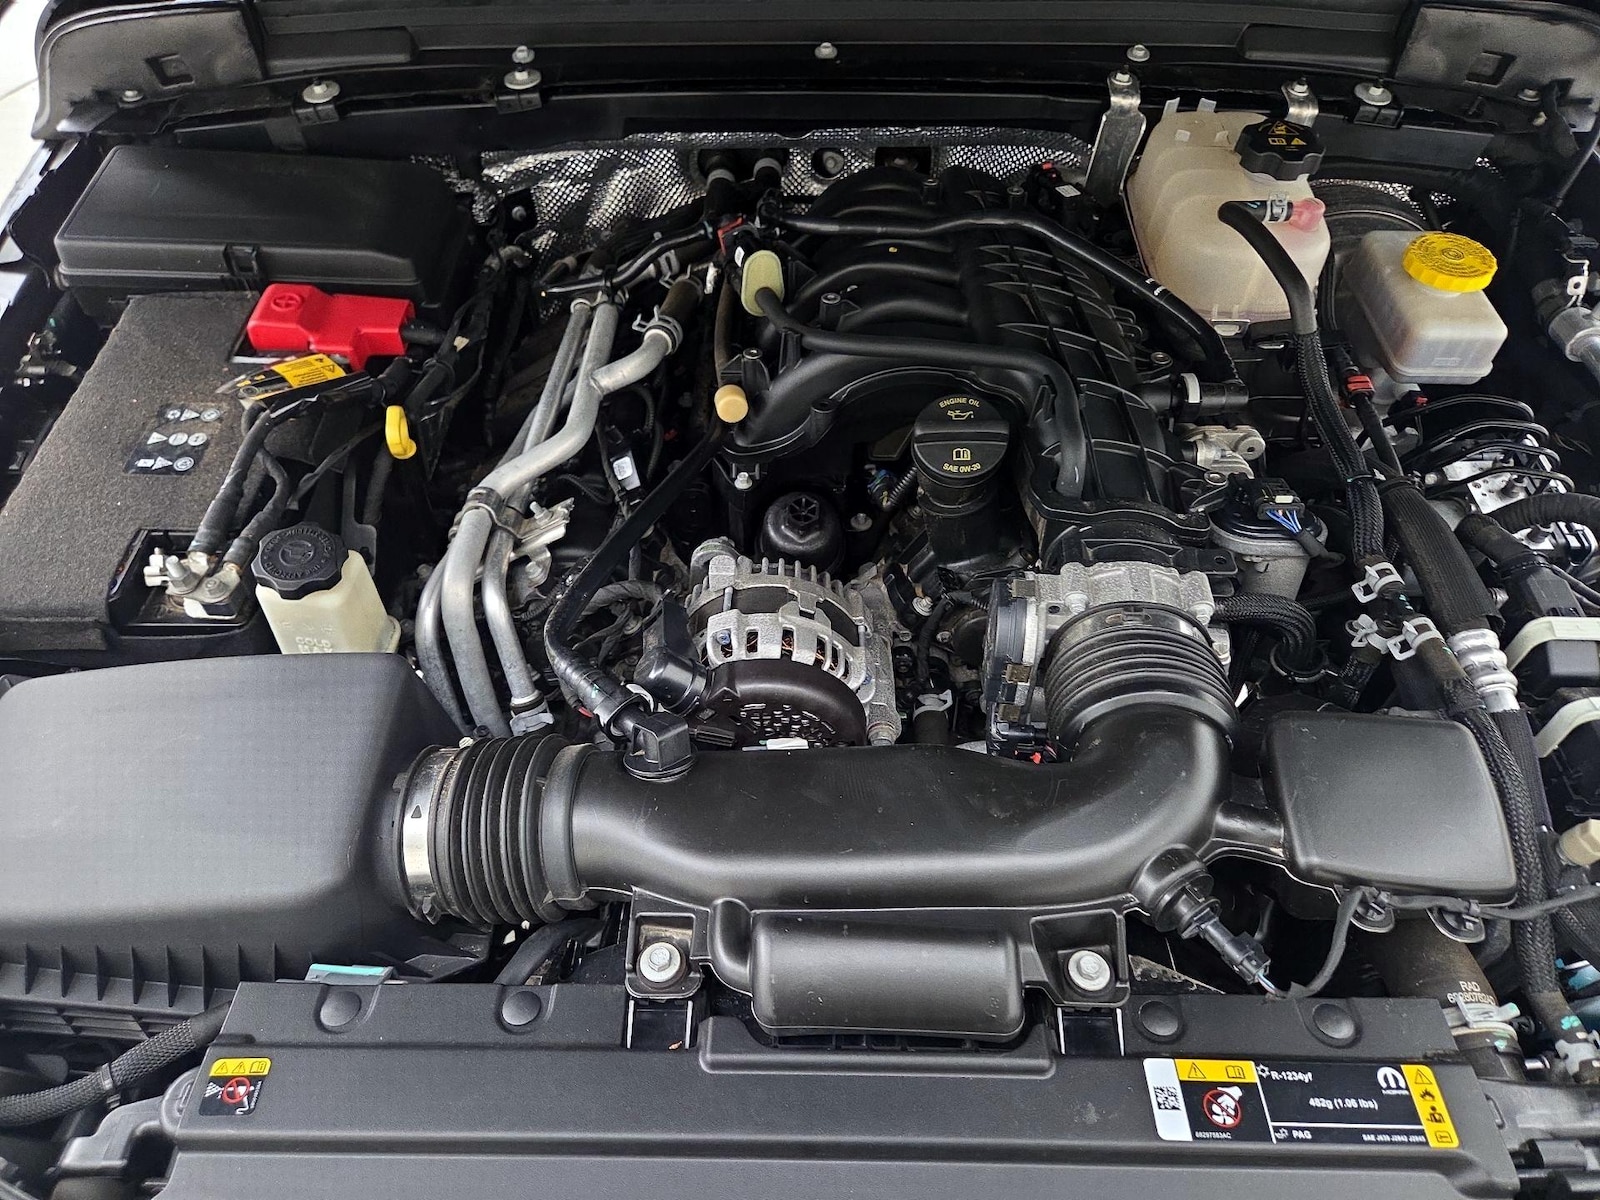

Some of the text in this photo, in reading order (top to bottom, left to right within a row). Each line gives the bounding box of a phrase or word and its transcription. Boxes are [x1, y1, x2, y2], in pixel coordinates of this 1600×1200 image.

[939, 398, 980, 408] ENGINE OIL
[943, 463, 981, 472] SAE 0W-20
[296, 637, 331, 648] COLD
[1459, 981, 1481, 991] RAD
[1270, 1070, 1313, 1083] R-1234yf
[1358, 1098, 1379, 1111] lbs)
[1291, 1129, 1313, 1140] PAG
